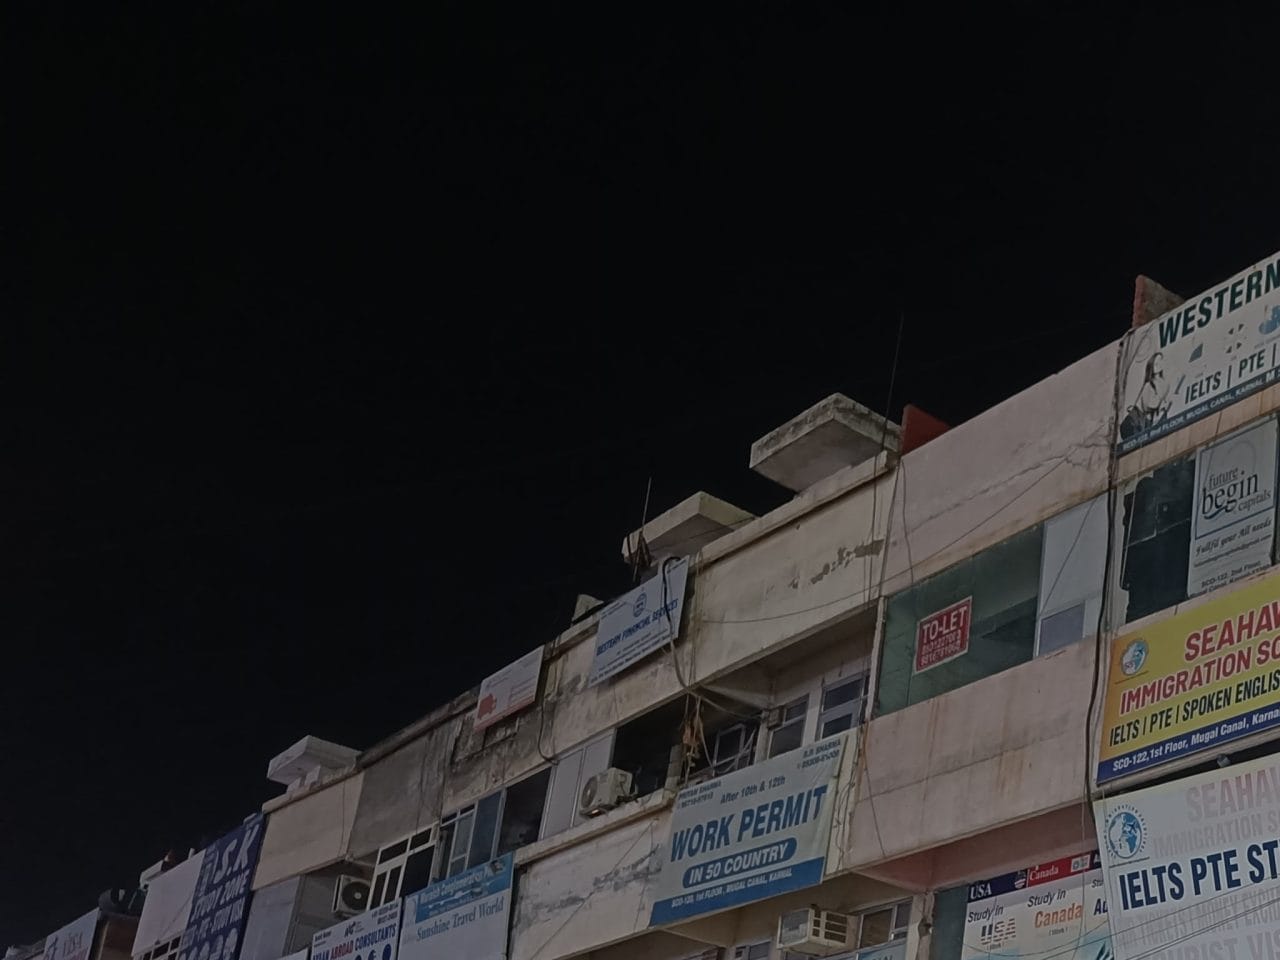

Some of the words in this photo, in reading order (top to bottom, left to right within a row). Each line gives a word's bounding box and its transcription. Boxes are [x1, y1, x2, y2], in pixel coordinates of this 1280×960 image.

[1185, 370, 1222, 405] IELTS
[1238, 349, 1267, 379] PTE
[1119, 652, 1252, 716] IMMIGRATION
[1109, 716, 1141, 748] IELTS
[1148, 706, 1173, 735] PTE
[1182, 686, 1233, 725] SPOKEN
[1191, 728, 1219, 753] Mugal
[1219, 717, 1251, 742] Canal,
[670, 812, 736, 862] WORK
[737, 783, 829, 844] PERMIT
[689, 866, 704, 884] IN
[705, 861, 721, 879] 50
[723, 841, 789, 875] COUNTRY
[969, 884, 993, 900] USA
[1028, 866, 1060, 882] Canada
[1119, 859, 1185, 910] IELTS
[1190, 848, 1242, 896] PTE
[416, 919, 451, 943] Sunshine
[452, 905, 477, 929] Travel
[477, 896, 505, 919] World
[967, 908, 994, 924] Study
[1027, 894, 1056, 908] Study
[1034, 902, 1083, 928] Canada
